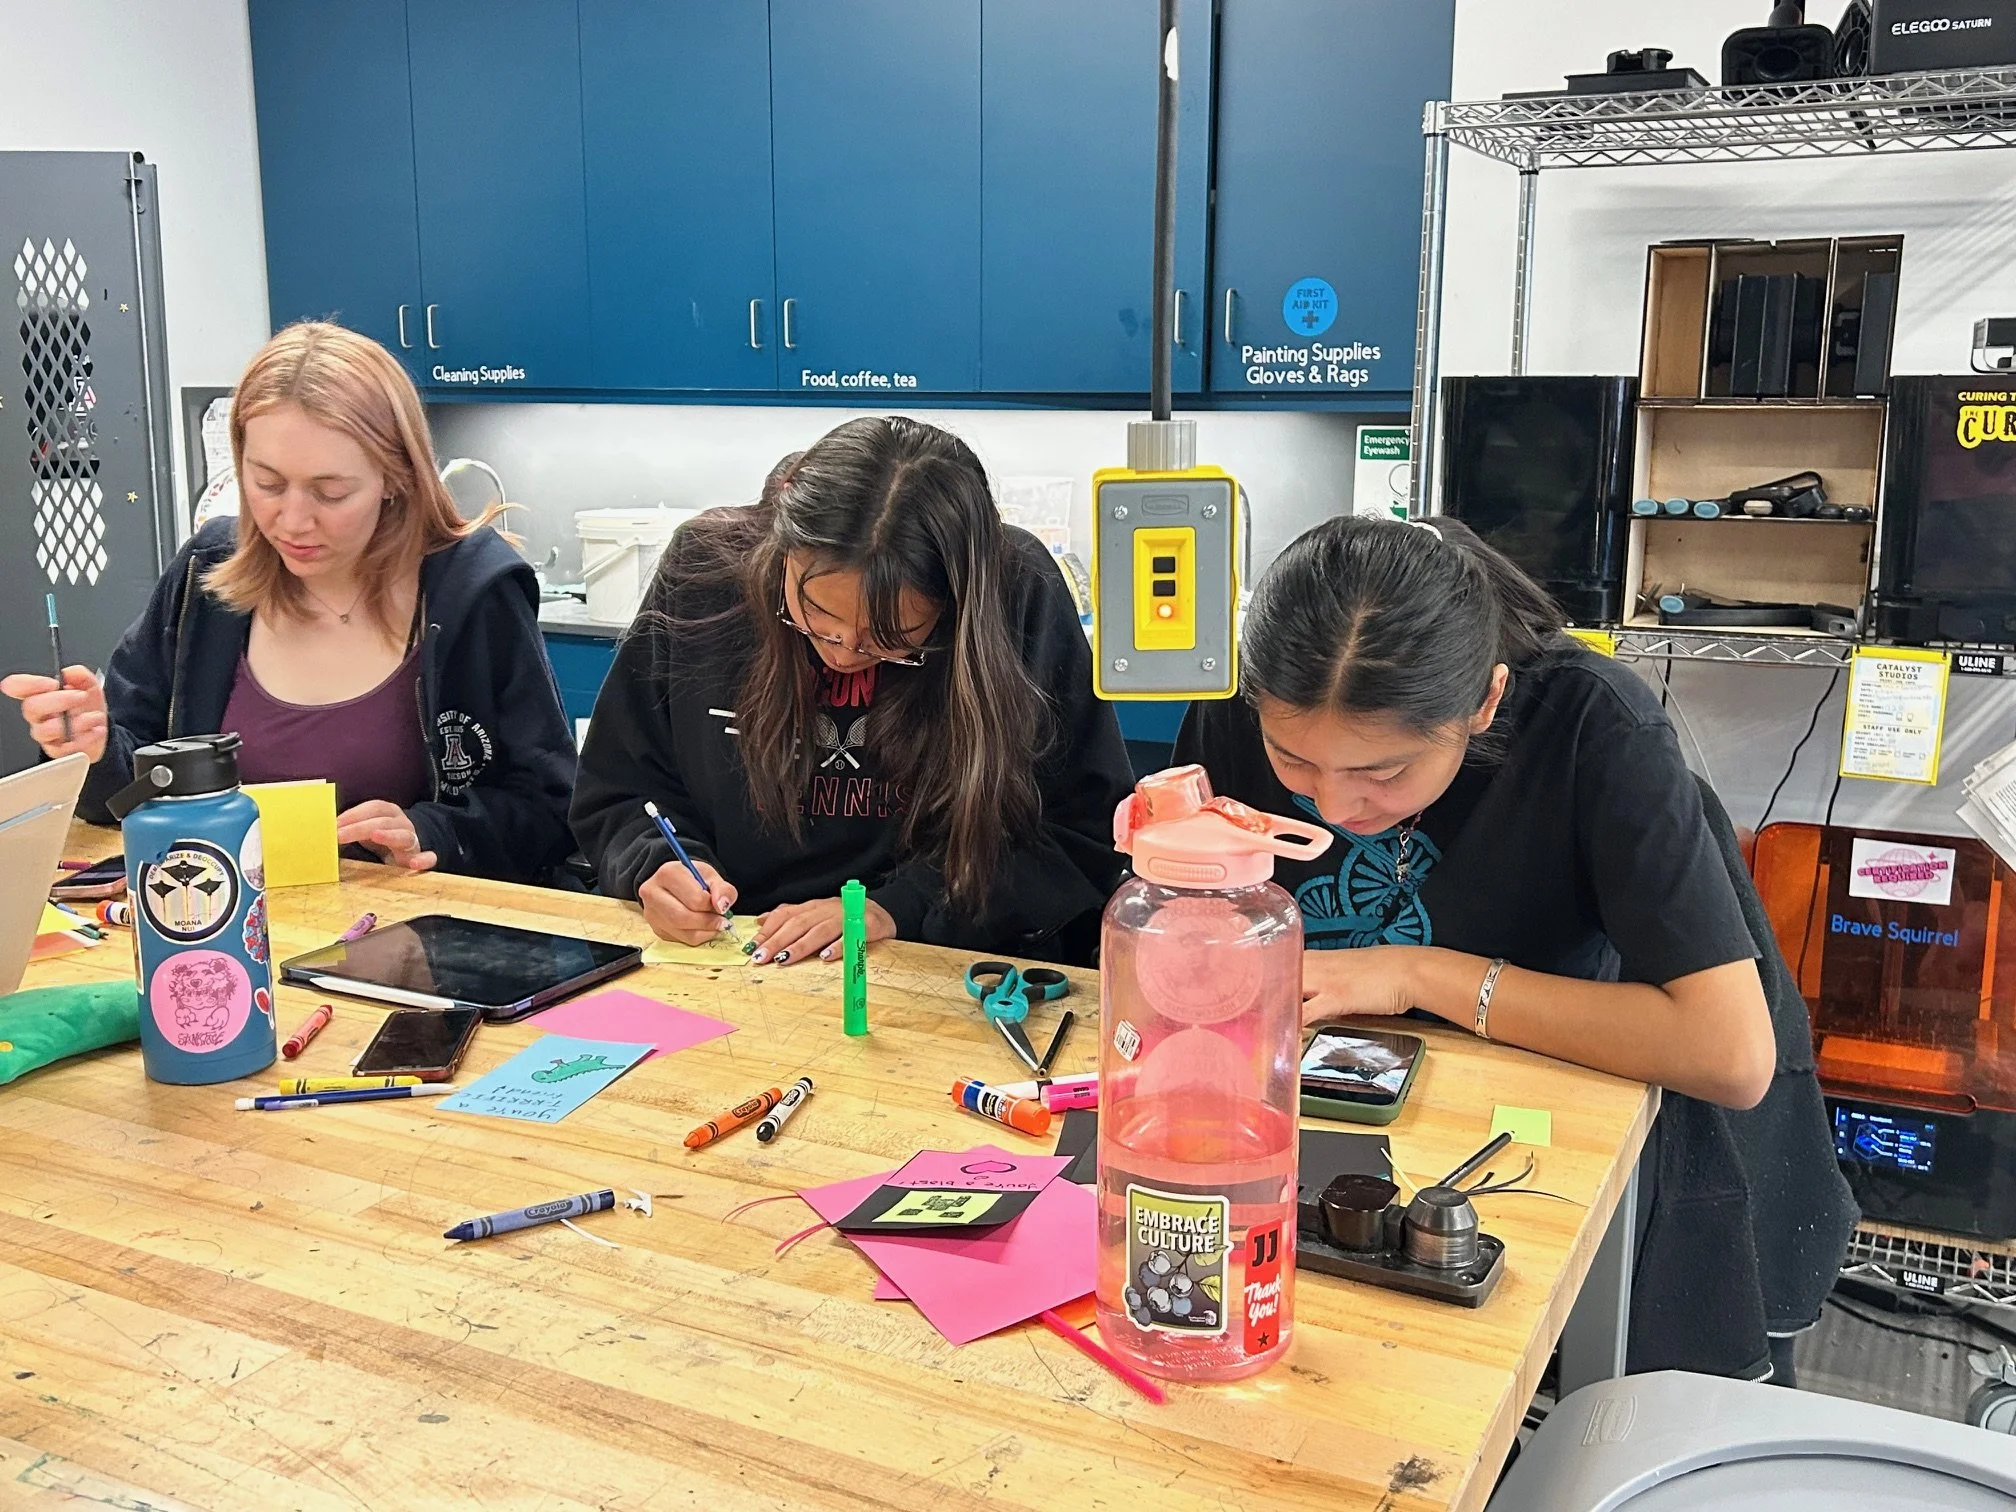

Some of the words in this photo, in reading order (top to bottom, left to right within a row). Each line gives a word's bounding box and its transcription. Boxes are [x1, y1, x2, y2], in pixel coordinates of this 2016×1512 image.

[1891, 19, 1950, 35] ELEGOO
[1951, 18, 1992, 29] SATURN
[1297, 288, 1325, 298] FIRST
[1292, 300, 1310, 309] AID
[1312, 299, 1329, 309] KIT
[1242, 345, 1308, 366] Painting
[1312, 342, 1381, 364] Supplies
[432, 365, 479, 385] Cleaning
[480, 365, 526, 383] Supplies
[802, 369, 839, 388] Food,
[841, 370, 891, 388] coffee,
[893, 372, 917, 387] tea
[1246, 366, 1305, 384] Gloves
[1308, 365, 1323, 383] &
[1327, 364, 1369, 387] Rags
[1957, 391, 2008, 402] CURING
[1363, 435, 1410, 446] Emergency
[1363, 446, 1400, 456] Eyewash
[1876, 663, 1923, 673] CATALYST
[1958, 655, 1996, 669] ULINE
[1878, 671, 1919, 680] STUDIOS
[1863, 724, 1884, 732] STAFF
[1857, 860, 1949, 877] CERTIFICATION
[1873, 871, 1935, 884] REQUIRED
[1831, 913, 1882, 937] Brave
[1888, 921, 1959, 947] Squirrel
[527, 1201, 567, 1216] Crayola
[1135, 1206, 1220, 1235] EMBRACE
[1137, 1226, 1216, 1253] CULTURE
[1244, 1273, 1282, 1301] Thank
[1903, 1270, 1938, 1288] ULINE
[1248, 1294, 1279, 1327] You!
